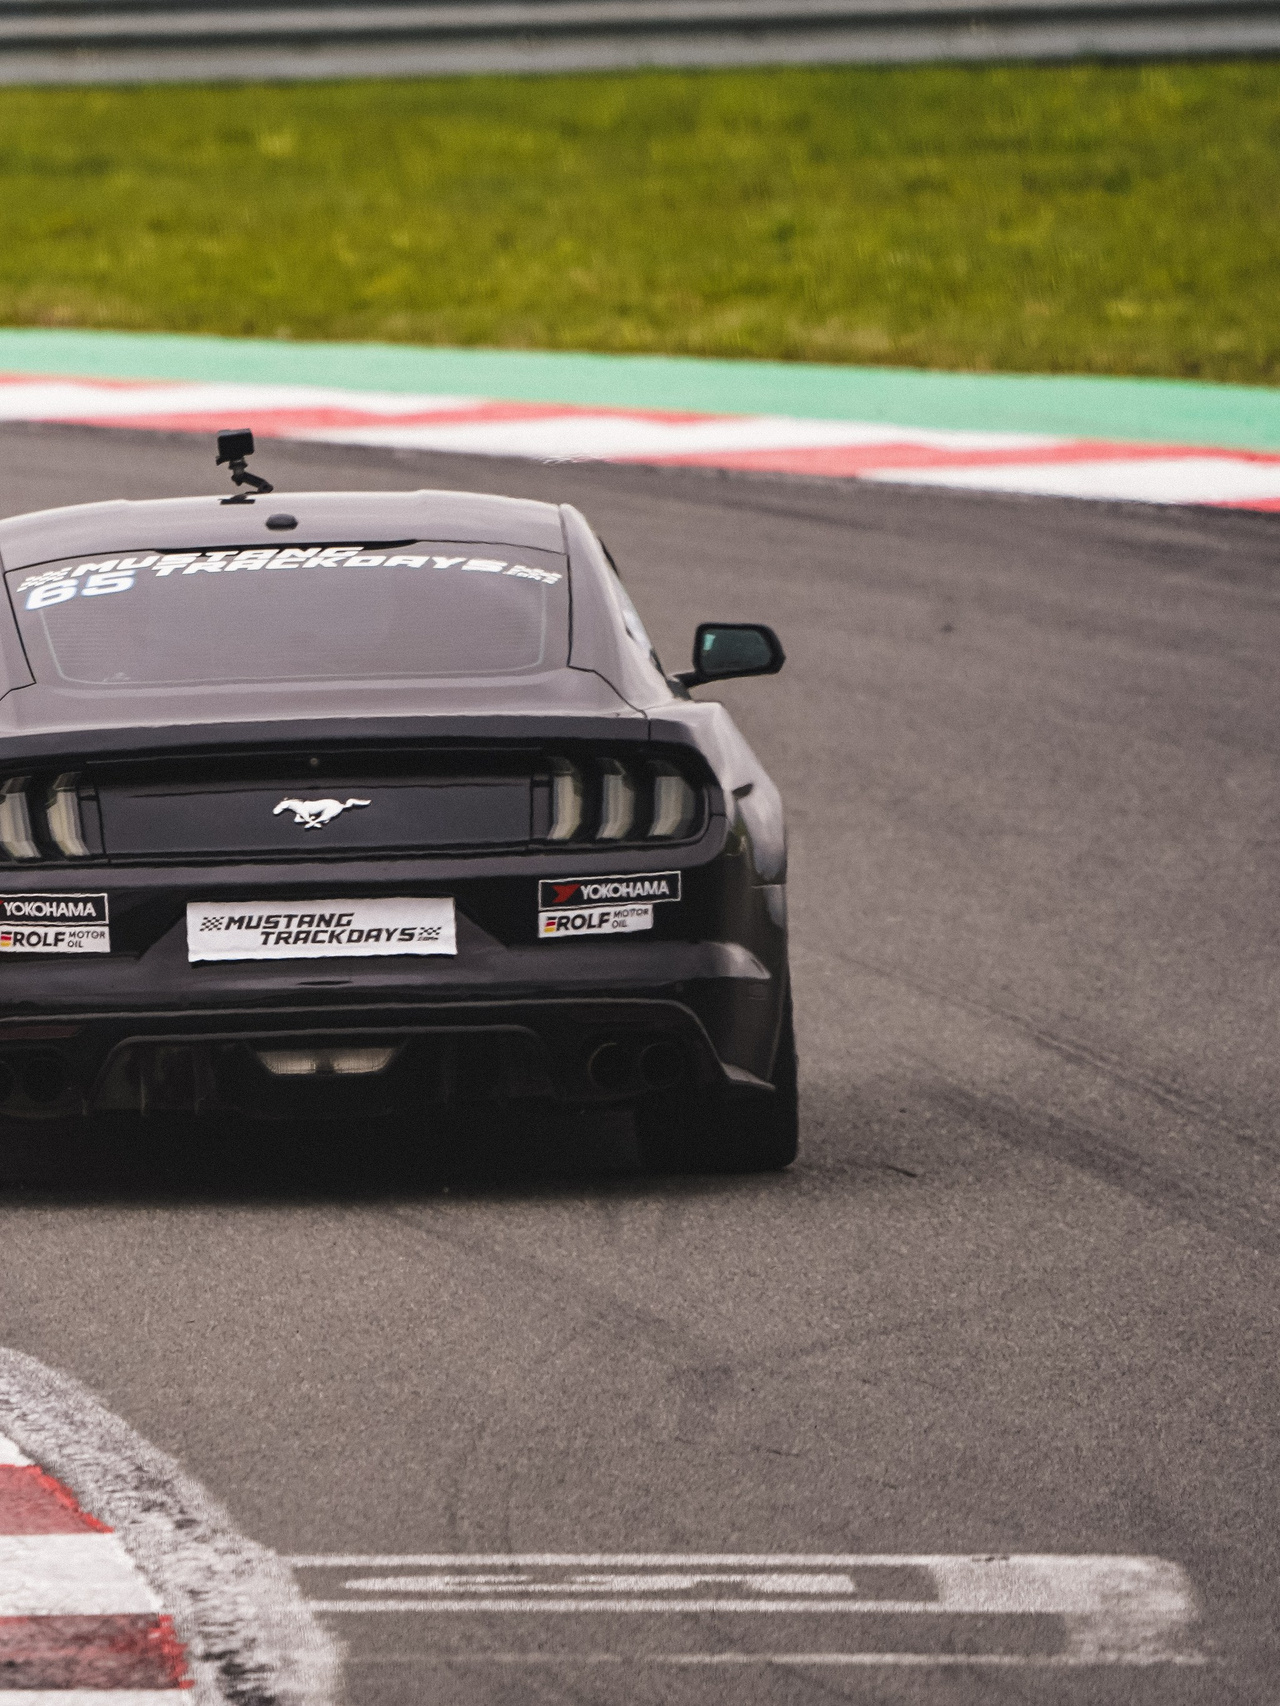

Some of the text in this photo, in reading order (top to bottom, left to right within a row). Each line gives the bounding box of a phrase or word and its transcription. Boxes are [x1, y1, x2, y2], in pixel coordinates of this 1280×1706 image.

[70, 546, 365, 578] MUSTANG
[154, 555, 508, 577] TRACKDAYS
[24, 569, 136, 611] 65
[580, 880, 670, 900] YOKOHAMA
[3, 901, 97, 918] YOKOHAMA
[613, 907, 650, 918] MOTOR
[224, 912, 355, 930] MUSTANG
[555, 912, 611, 932] ROLF
[611, 919, 628, 929] OIL
[12, 931, 66, 948] ROLF
[67, 940, 84, 949] OIL
[68, 931, 106, 940] MOTOR
[261, 927, 417, 946] TRACKDAYS
